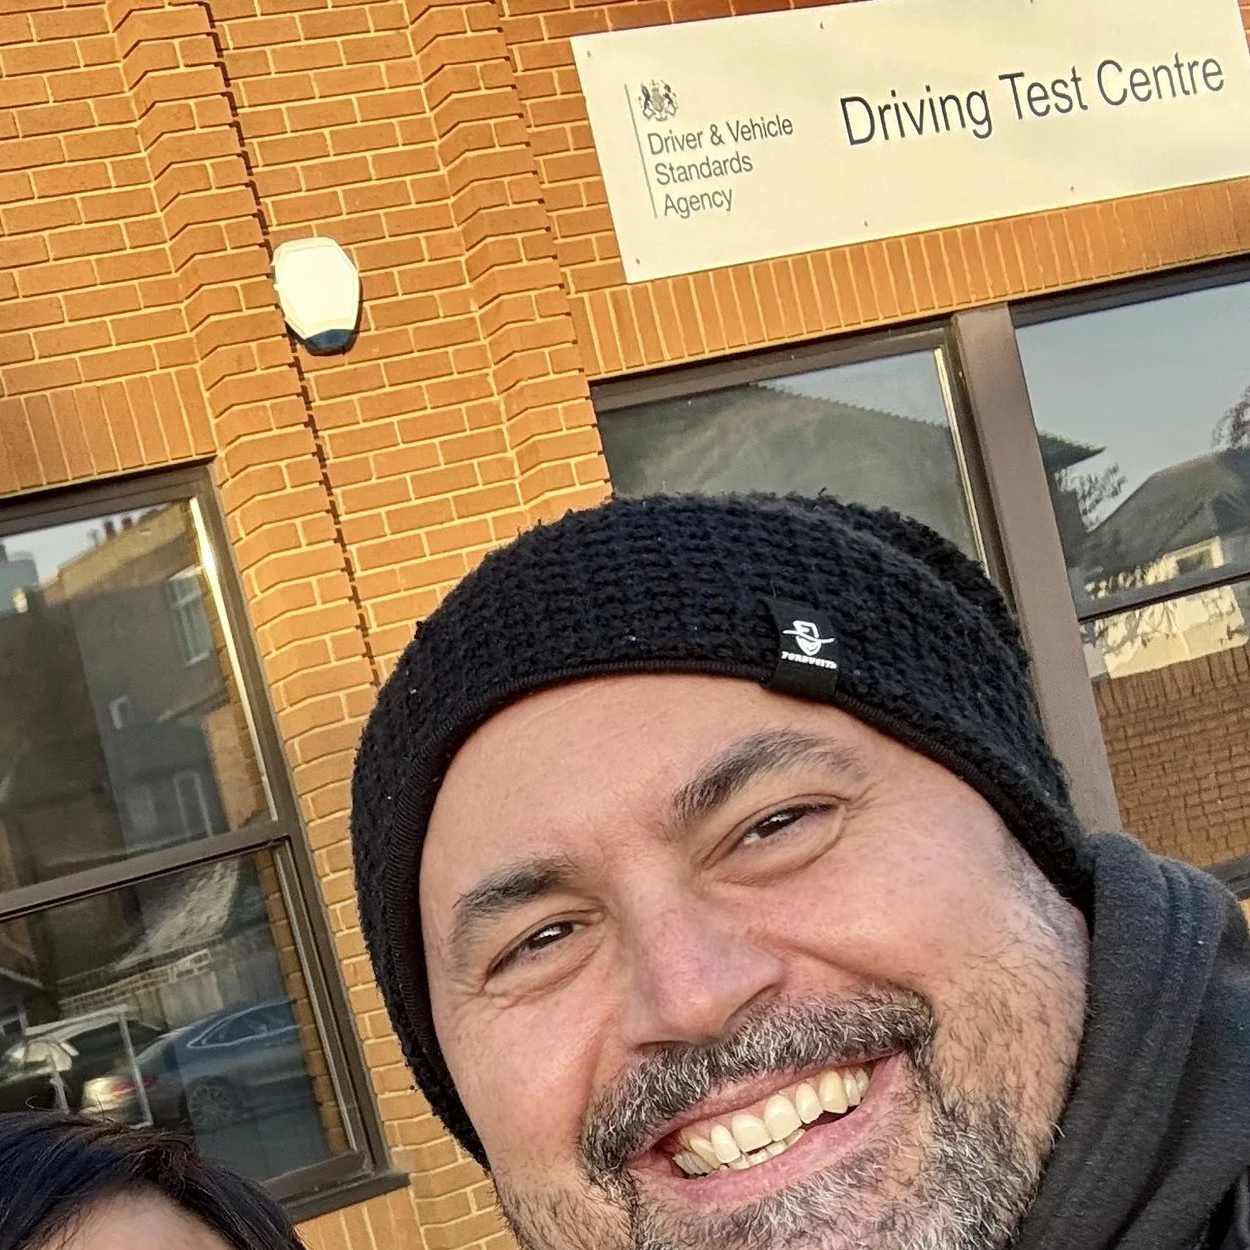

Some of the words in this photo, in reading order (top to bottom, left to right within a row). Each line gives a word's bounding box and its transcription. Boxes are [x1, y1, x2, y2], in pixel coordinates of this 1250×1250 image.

[840, 84, 992, 147] Driving
[998, 63, 1088, 121] Test
[1096, 52, 1225, 107] Centre
[649, 128, 704, 155] Driver
[710, 123, 725, 146] &
[726, 113, 794, 144] Vehicle
[655, 152, 753, 186] Standards
[663, 187, 733, 217] Agency
